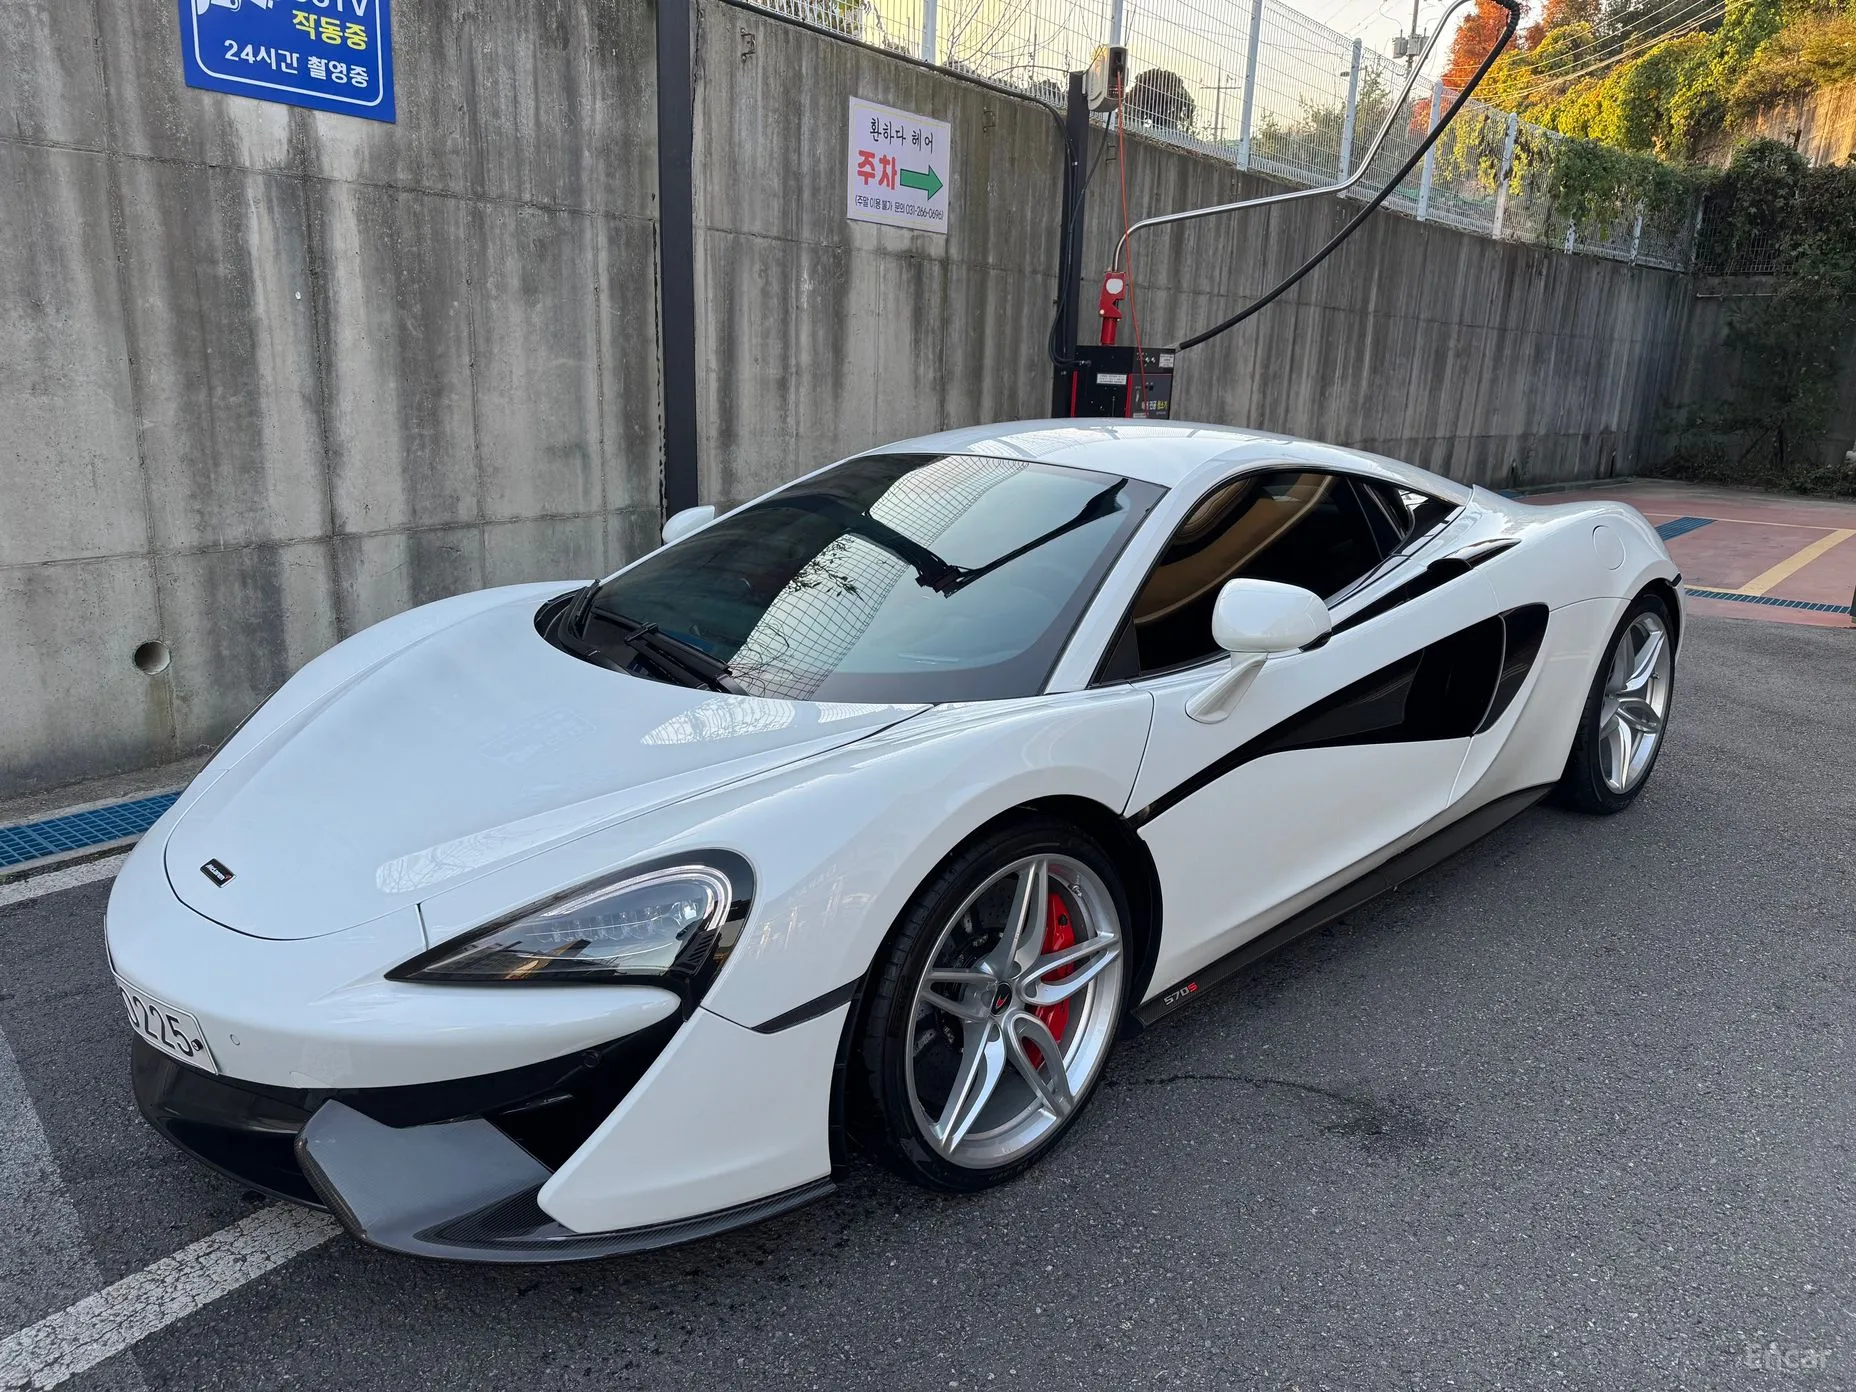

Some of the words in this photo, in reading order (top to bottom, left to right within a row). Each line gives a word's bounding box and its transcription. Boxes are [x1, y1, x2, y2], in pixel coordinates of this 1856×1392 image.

[292, 9, 368, 50] 작동중
[223, 39, 300, 74] 24시간
[307, 55, 369, 88] 촬영중
[869, 117, 906, 146] 환하다
[911, 128, 934, 155] 헤어
[857, 149, 898, 191] 주차
[869, 196, 881, 210] 이용
[881, 199, 893, 212] 불가
[894, 201, 905, 214] 문의
[1163, 982, 1198, 1006] 570S
